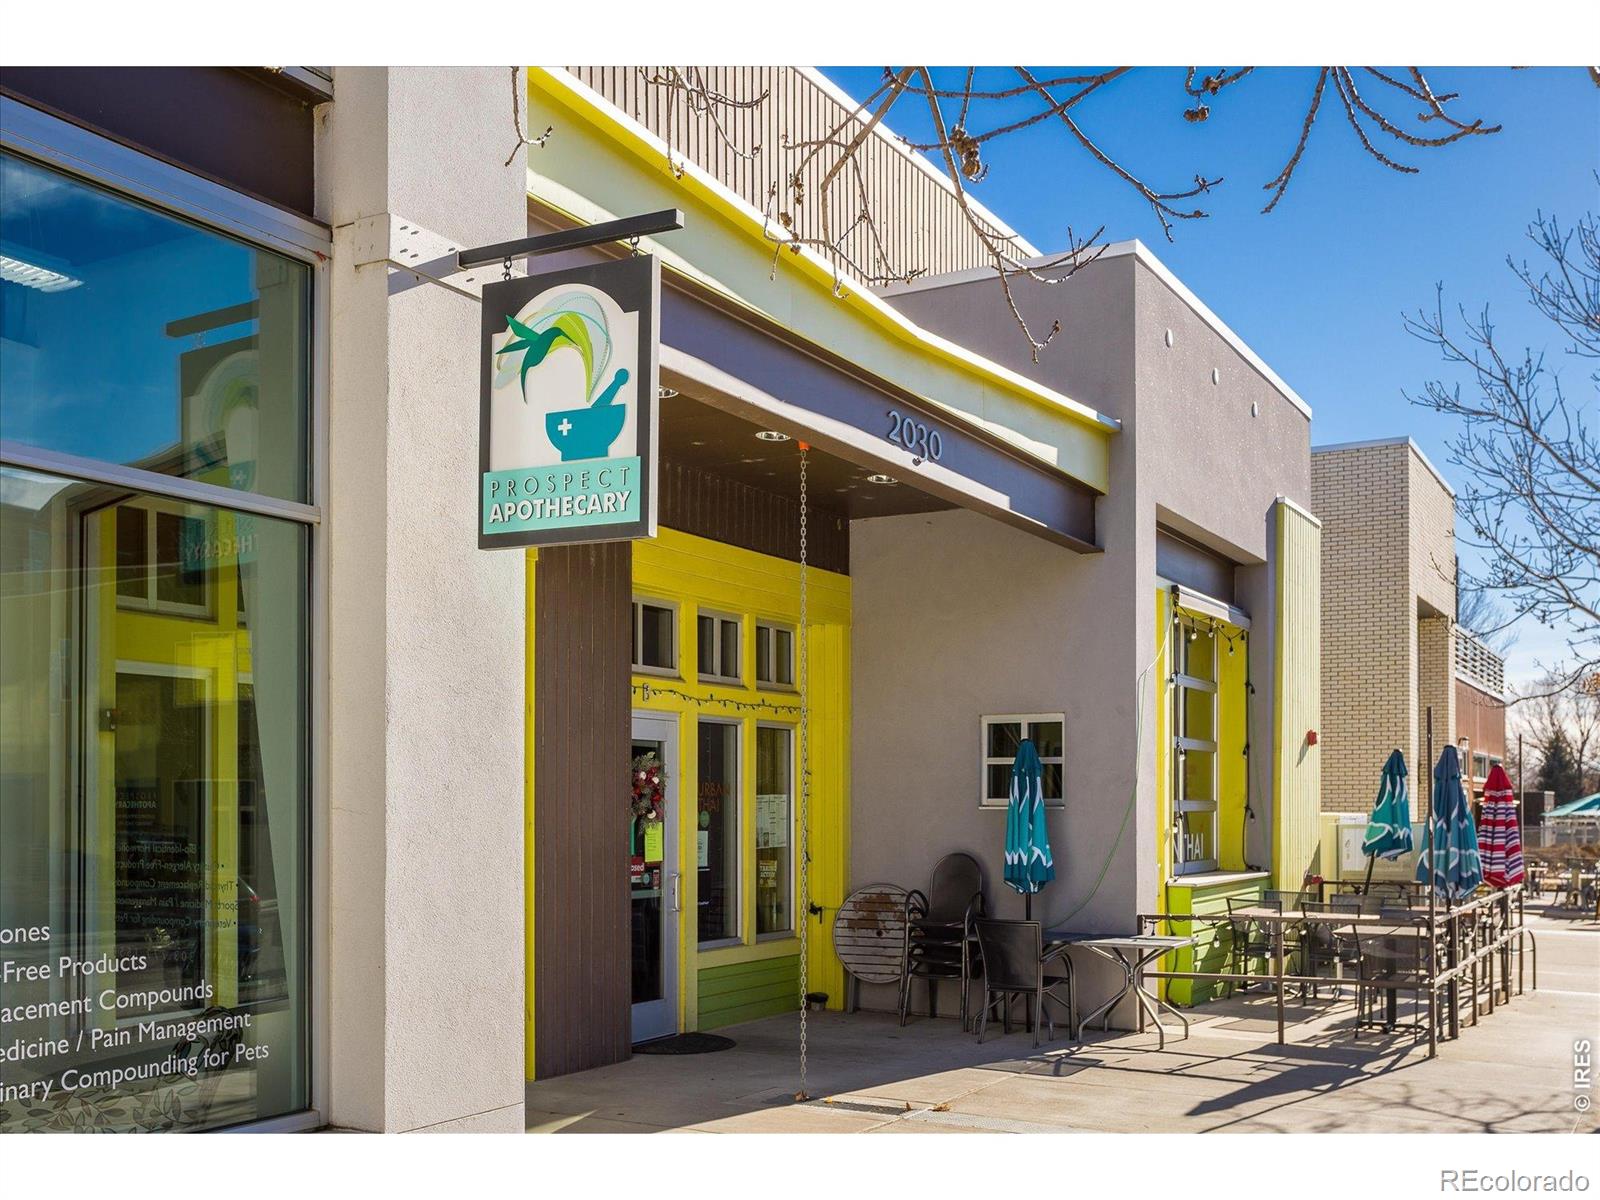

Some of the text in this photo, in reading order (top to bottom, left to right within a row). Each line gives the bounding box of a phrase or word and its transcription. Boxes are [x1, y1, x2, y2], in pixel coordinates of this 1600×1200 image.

[887, 410, 943, 464] 2030
[490, 466, 631, 498] PROSPECT
[489, 491, 632, 524] APOTHECARY
[0, 926, 50, 944] ones
[59, 953, 147, 978] Products
[0, 979, 214, 1023] acement Compounds
[0, 1013, 251, 1063] edicine / Pain Management
[61, 1053, 198, 1091] Compounding
[203, 1048, 230, 1070] for
[235, 1043, 269, 1064] Pets
